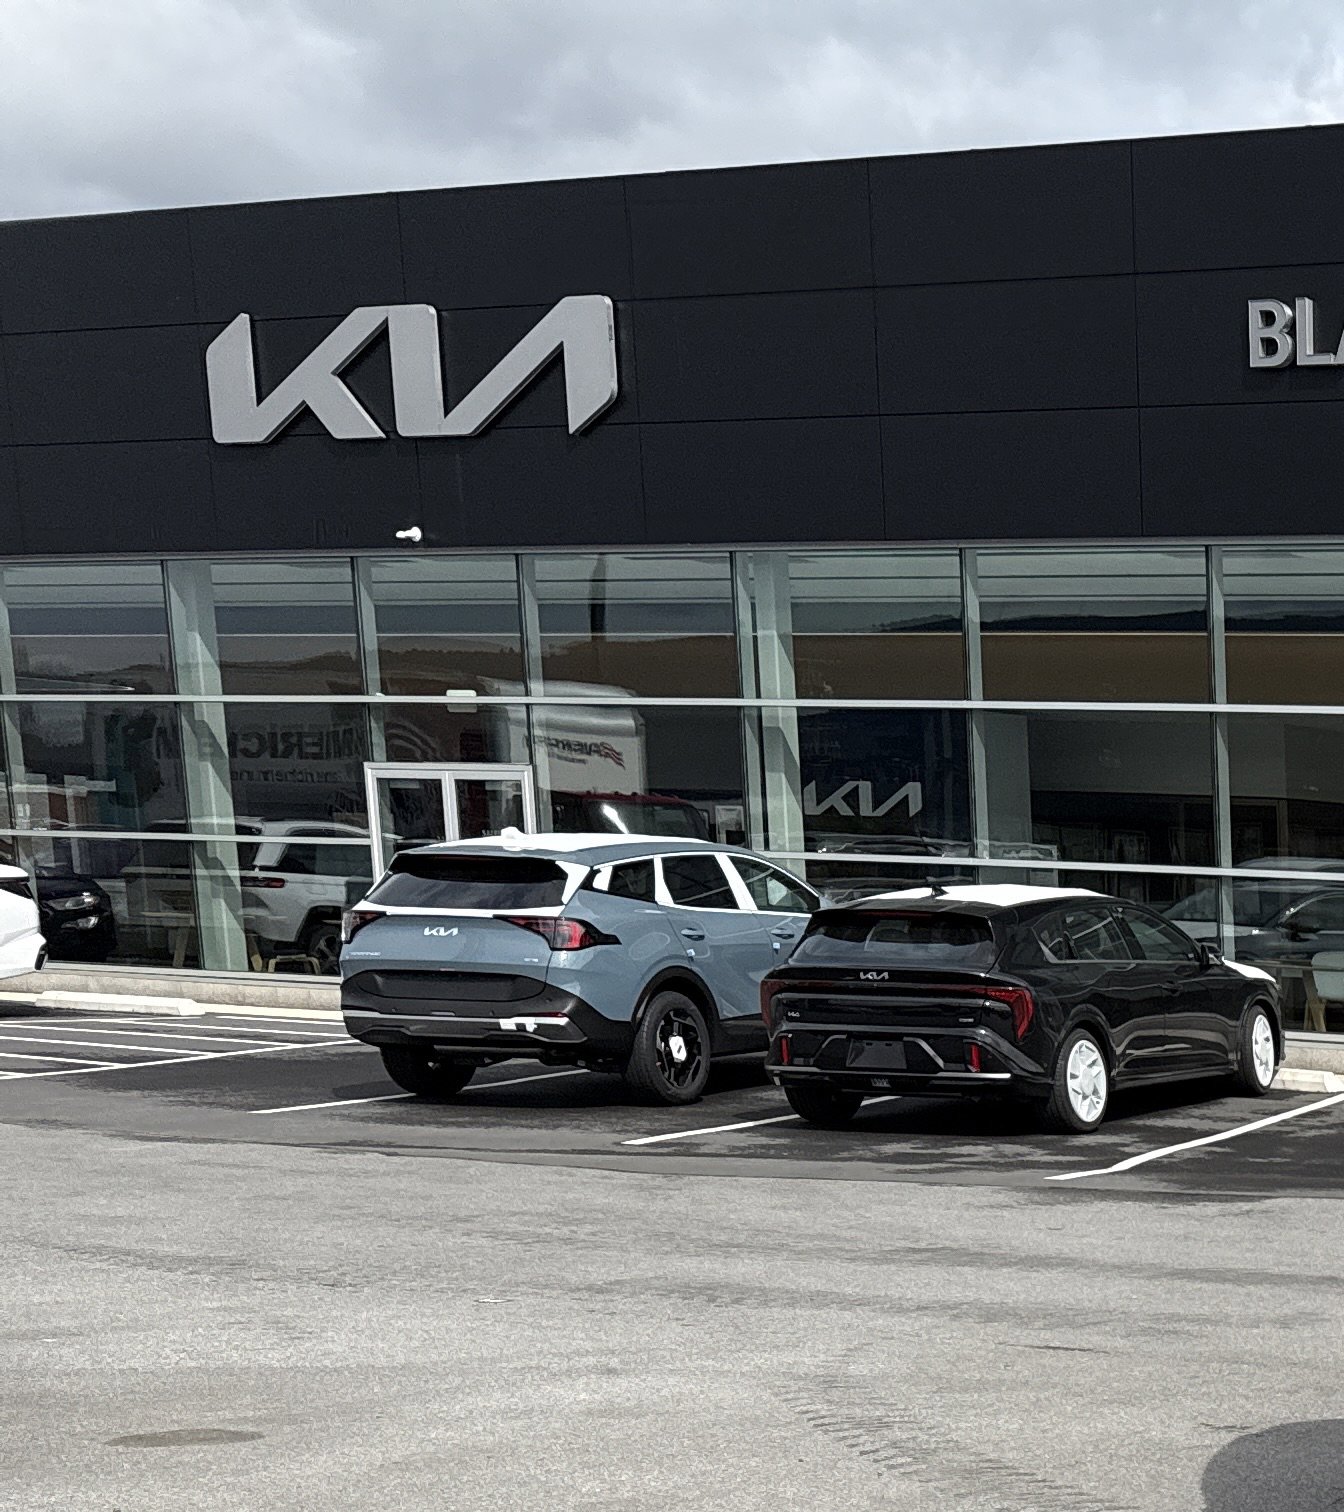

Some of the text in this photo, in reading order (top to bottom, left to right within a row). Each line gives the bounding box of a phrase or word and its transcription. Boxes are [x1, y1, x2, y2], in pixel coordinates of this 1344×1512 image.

[206, 295, 619, 445] KIA
[803, 780, 923, 818] KIA
[423, 926, 459, 937] KIA
[859, 971, 889, 980] KIA
